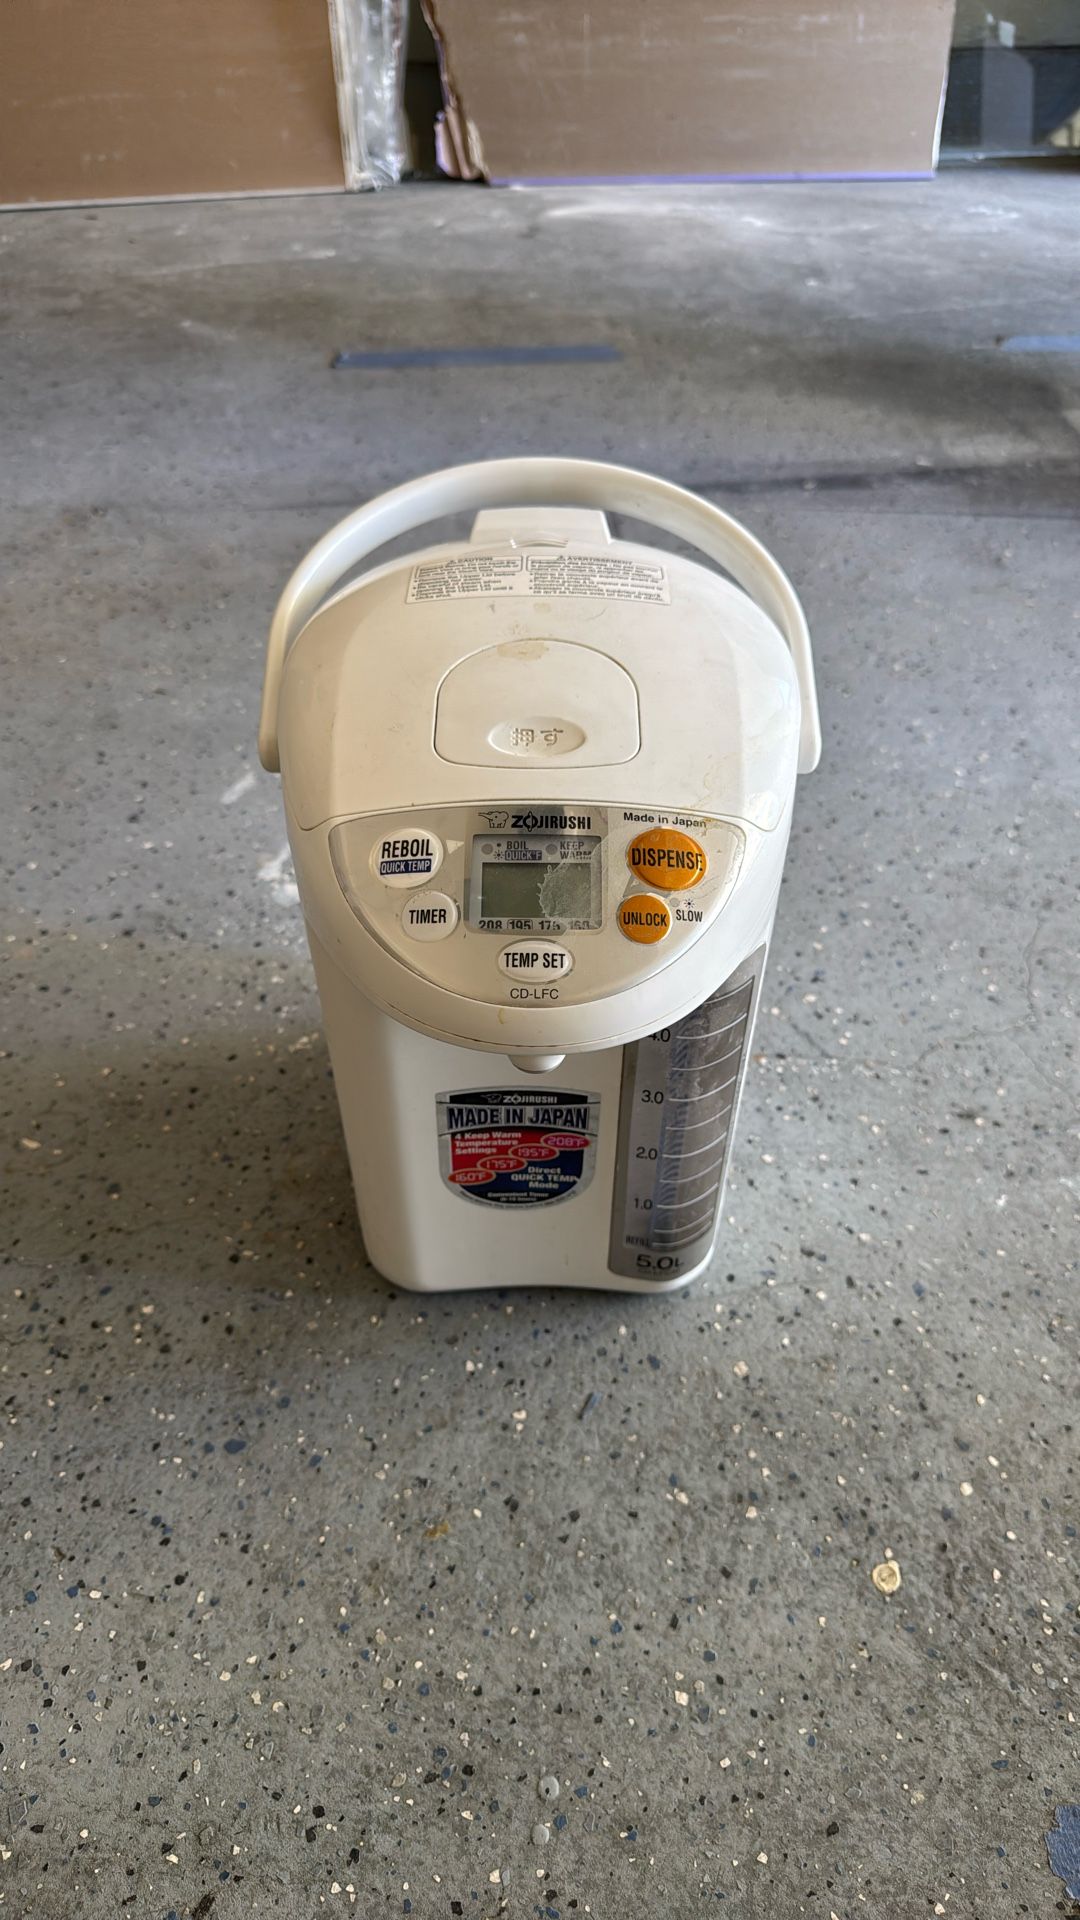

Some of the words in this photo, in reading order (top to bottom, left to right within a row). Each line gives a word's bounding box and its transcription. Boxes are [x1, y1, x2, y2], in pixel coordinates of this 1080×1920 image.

[510, 727, 564, 752] 押す
[511, 811, 591, 832] ZOJIRUSHI
[623, 812, 655, 823] Made
[658, 814, 669, 824] in
[672, 816, 707, 828] Japan
[381, 838, 433, 859] REBOIL
[506, 840, 529, 850] BOIL
[505, 850, 531, 861] QUICK
[631, 847, 703, 872] DISPENSE
[381, 861, 406, 874] QUICK
[408, 860, 430, 873] TEMP
[409, 908, 447, 925] TIMER
[623, 911, 668, 927] UNLOCK
[676, 909, 703, 923] SLOW
[504, 952, 539, 968] TEMP
[542, 952, 566, 969] SET
[509, 987, 559, 1000] CD-LFC
[502, 1093, 558, 1105] ZOJIRUSHI
[641, 1089, 664, 1105] 3.0
[448, 1106, 500, 1130] MADE
[504, 1107, 524, 1124] IN
[528, 1106, 588, 1130] JAPAN
[464, 1132, 490, 1141] Keep
[492, 1131, 522, 1139] Warm
[455, 1139, 519, 1148] Temperature
[455, 1146, 497, 1155] Settings
[635, 1146, 658, 1161] 2.0
[527, 1166, 562, 1174] Direct
[511, 1173, 544, 1182] QUICK
[546, 1174, 578, 1183] TEMP
[528, 1181, 560, 1190] Mode
[633, 1197, 653, 1210] 1.0
